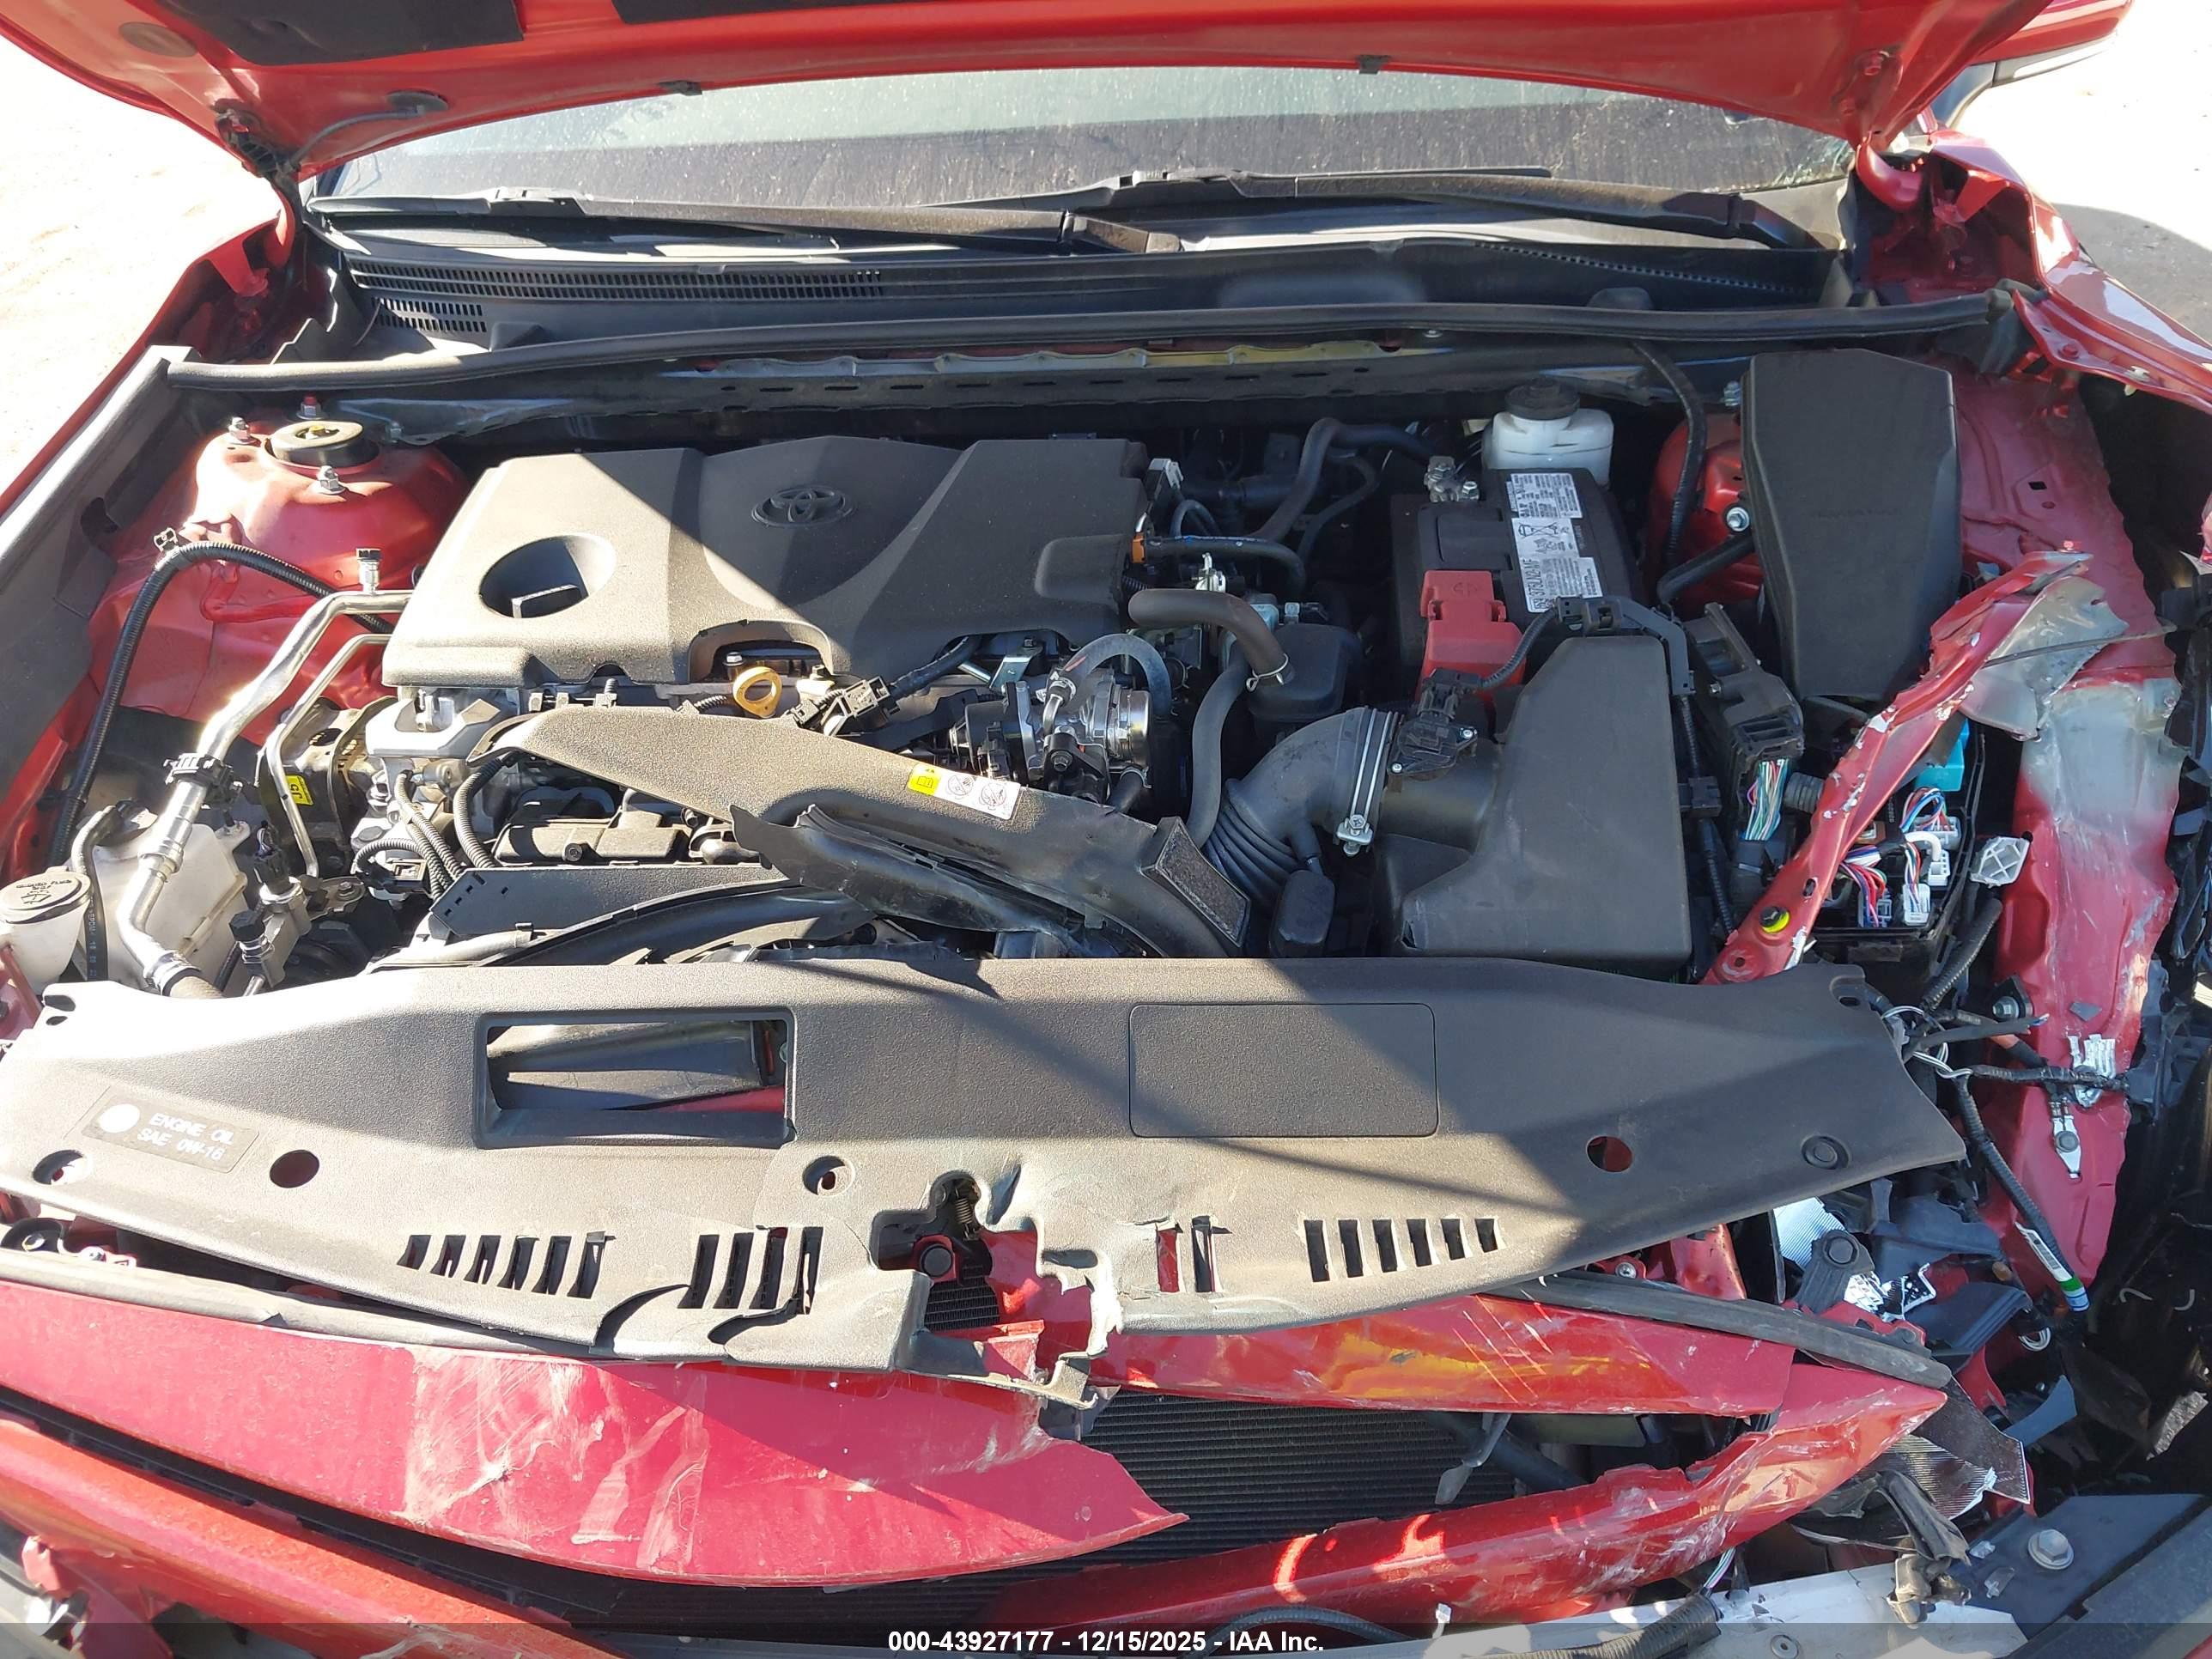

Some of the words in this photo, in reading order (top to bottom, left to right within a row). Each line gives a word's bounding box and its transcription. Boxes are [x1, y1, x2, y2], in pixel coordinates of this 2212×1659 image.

[137, 1127, 173, 1146] SAE
[176, 1139, 227, 1161] 0W-16
[149, 1112, 207, 1137] ENGINE
[210, 1128, 235, 1146] OIL
